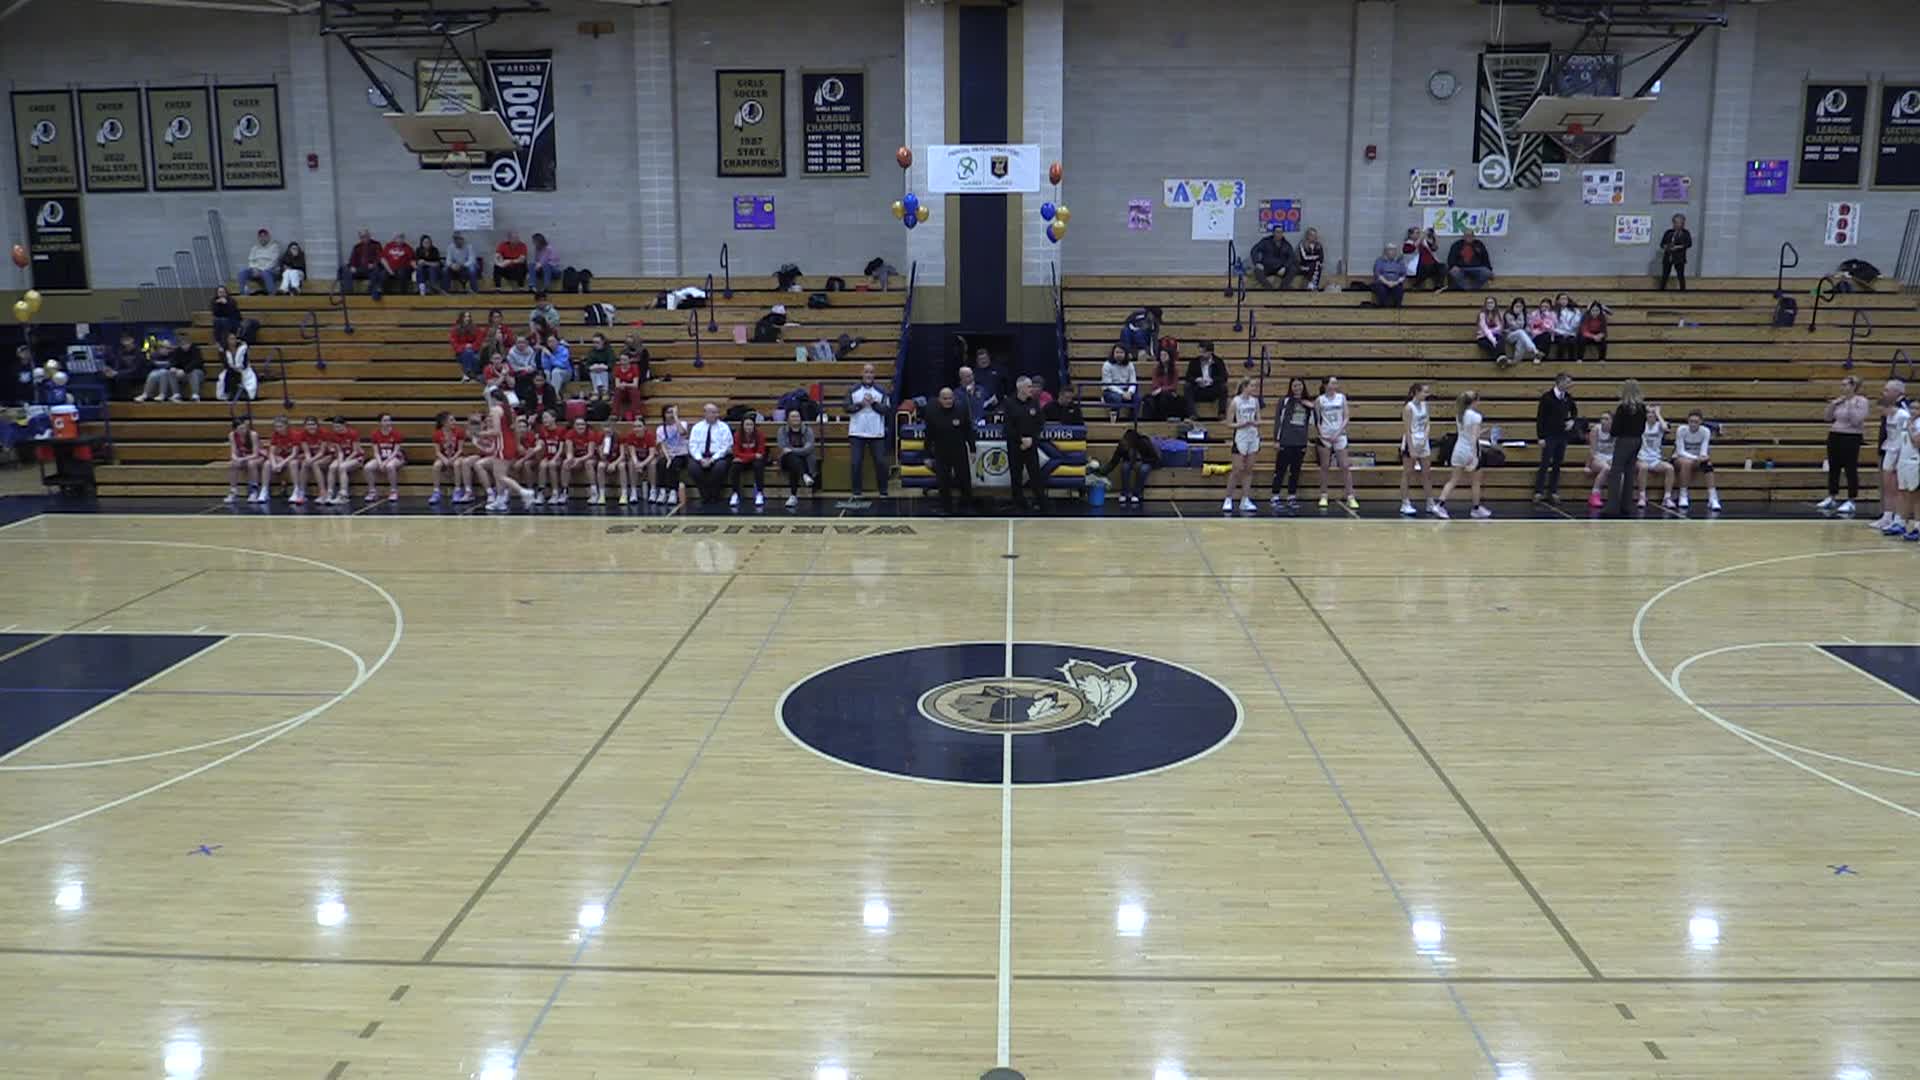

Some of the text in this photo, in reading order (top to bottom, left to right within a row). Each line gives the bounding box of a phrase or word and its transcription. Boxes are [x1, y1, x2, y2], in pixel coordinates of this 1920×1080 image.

[497, 64, 542, 72] WARRIOR
[737, 79, 765, 88] GIRLS
[733, 89, 768, 98] SOCCER
[498, 75, 543, 146] FOCUS
[816, 114, 850, 123] LEAGUE
[806, 123, 862, 133] CHAMPIONS
[1805, 135, 1861, 144] CHAMPIONS
[737, 148, 766, 156] STATE
[723, 159, 780, 168] CHAMPIONS
[605, 524, 918, 535] WARRIORS
